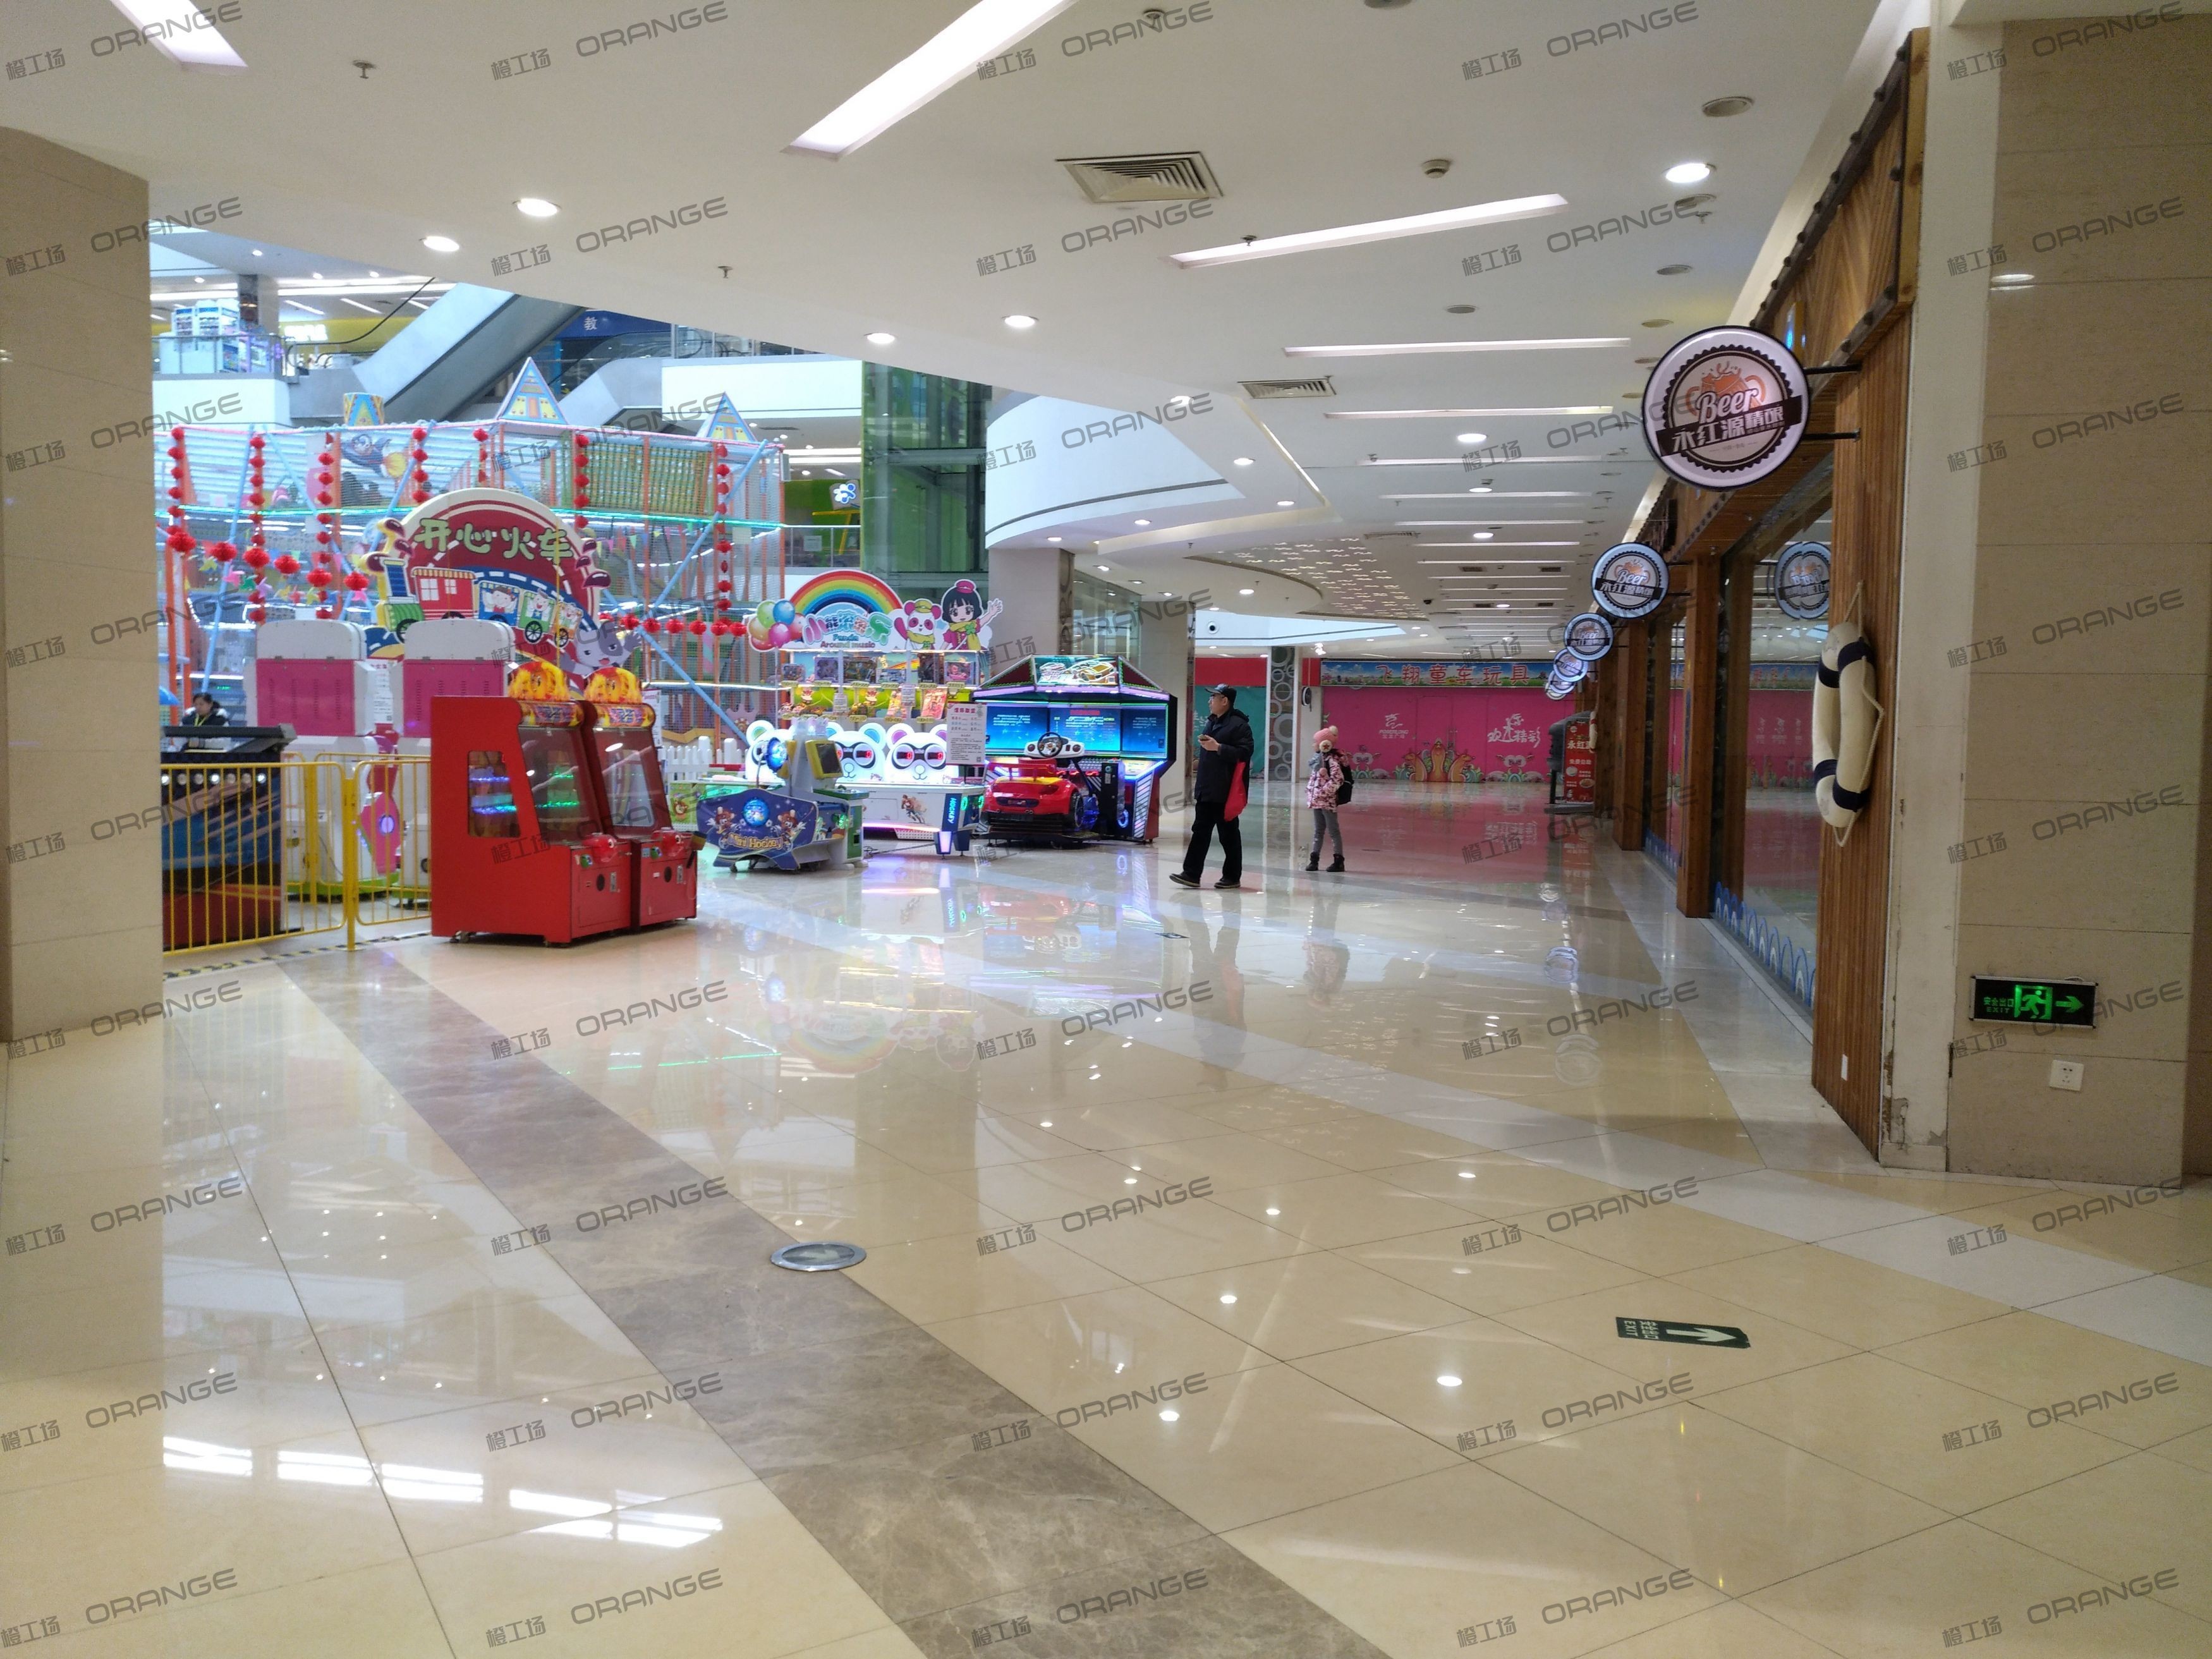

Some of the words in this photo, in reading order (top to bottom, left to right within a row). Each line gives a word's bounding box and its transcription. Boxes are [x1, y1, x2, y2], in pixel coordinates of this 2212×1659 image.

[1695, 388, 1758, 424] Beer
[1672, 406, 1785, 453] 永红源精酿
[414, 518, 574, 560] 开心火车
[1617, 569, 1647, 585] Beer
[1375, 664, 1531, 685] 飞翔童车玩具
[1983, 997, 2014, 1007] 安全出口
[1624, 1320, 1638, 1337] EXIT
